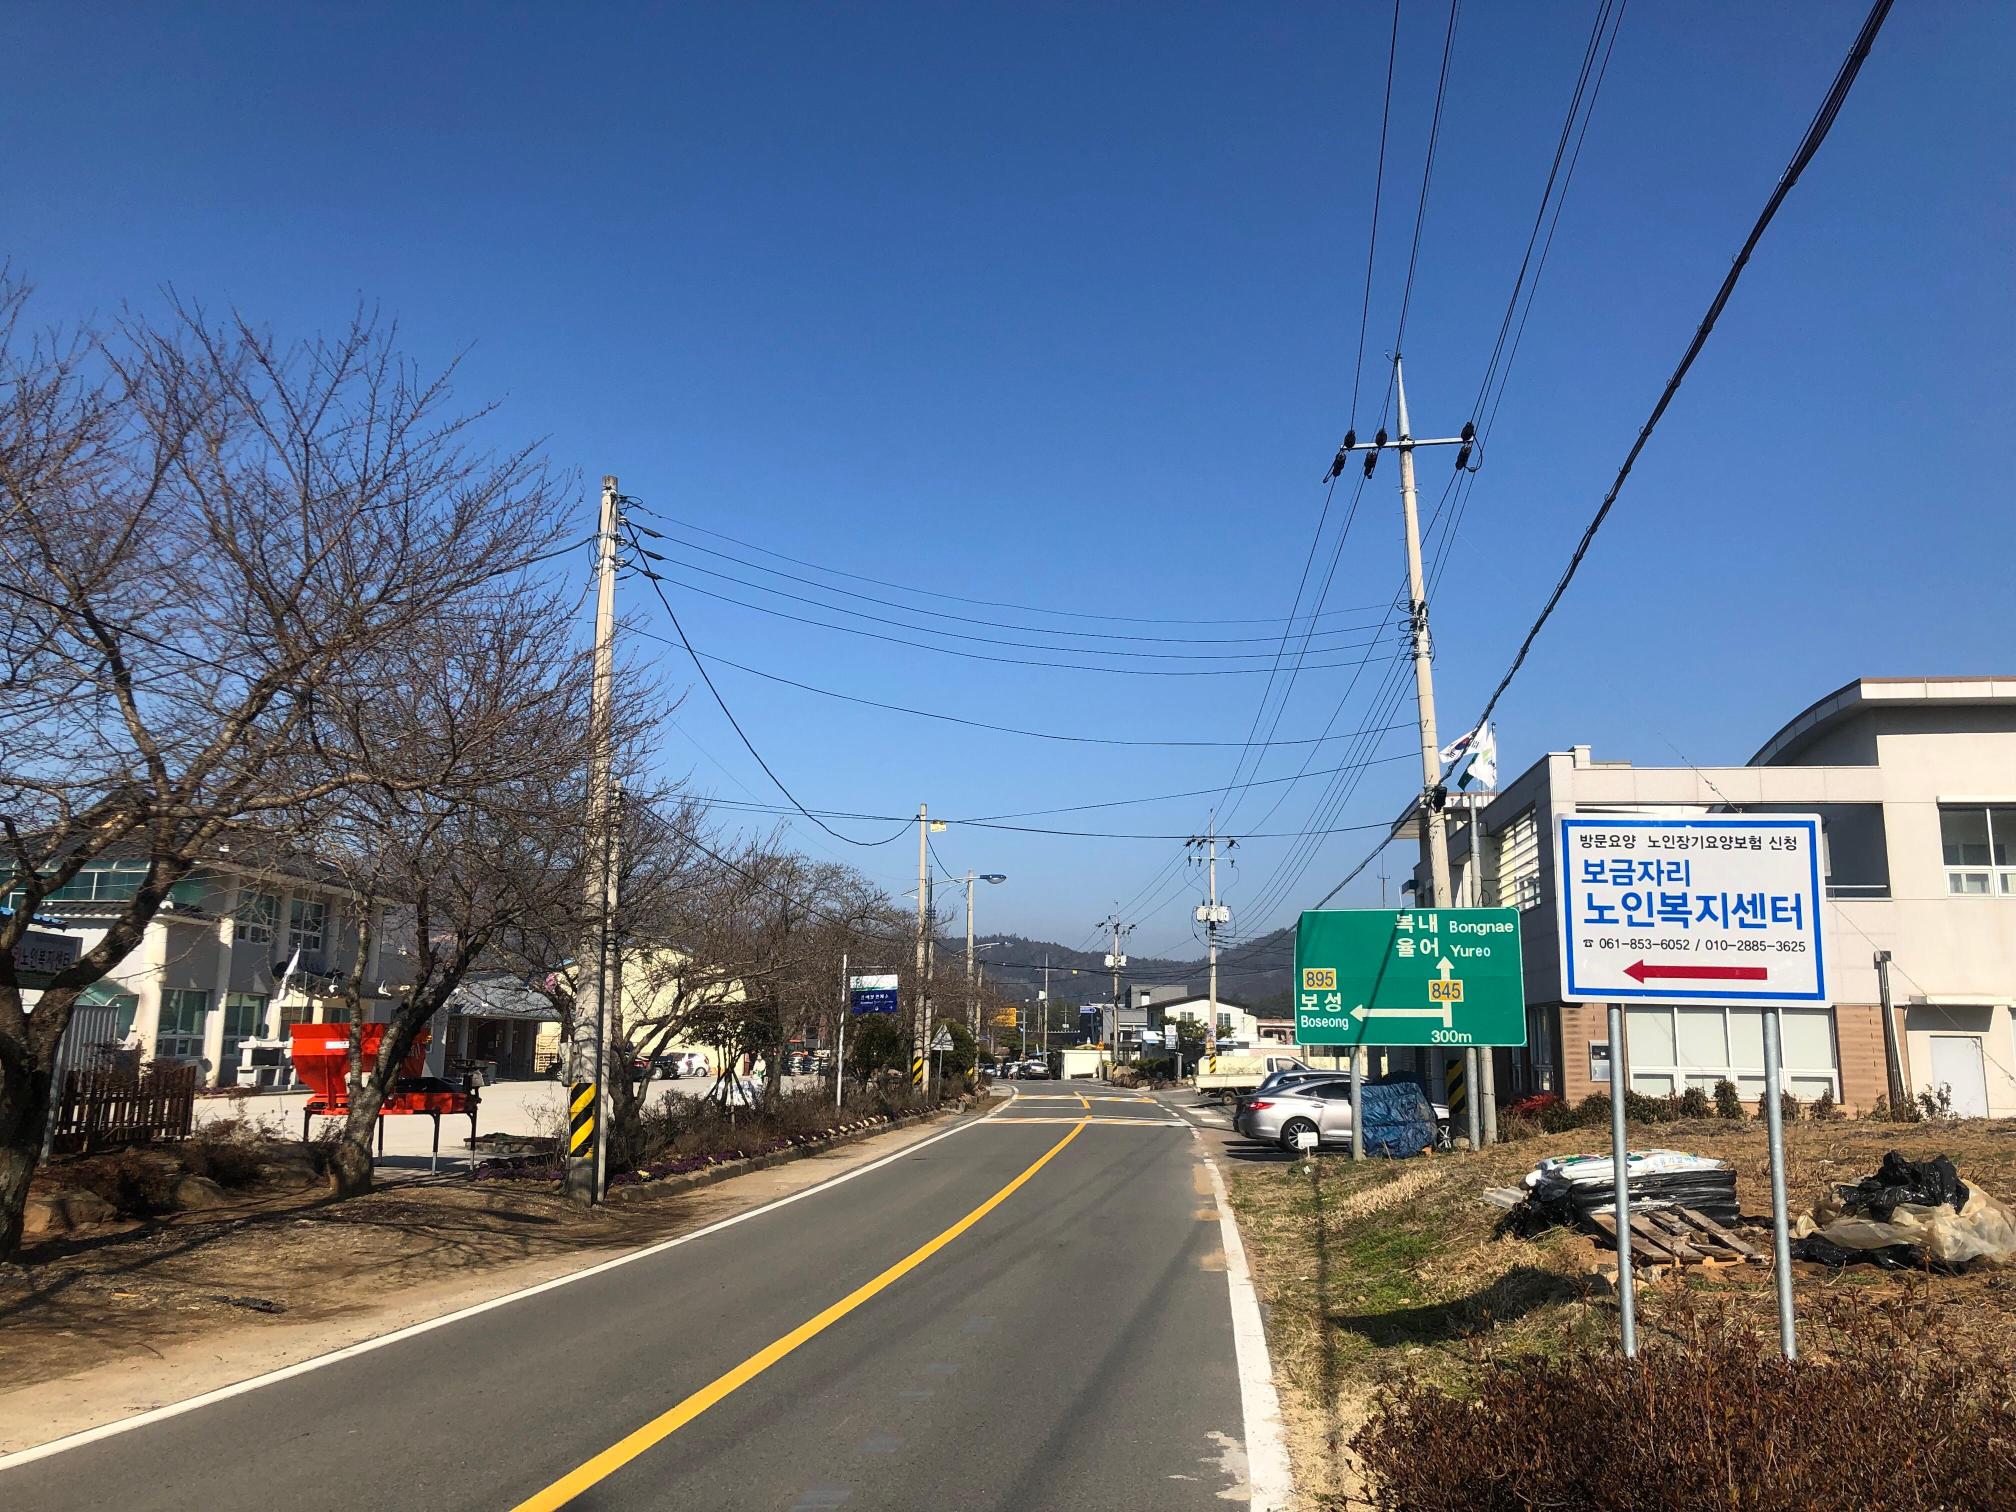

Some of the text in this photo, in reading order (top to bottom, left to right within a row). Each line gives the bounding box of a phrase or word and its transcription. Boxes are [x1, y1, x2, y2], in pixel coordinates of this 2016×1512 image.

[1579, 833, 1798, 851] 방문요양 노인장기요양보험 신청
[1581, 858, 1690, 887] 보금자리
[1583, 891, 1803, 930] 노인복지센터
[1394, 913, 1514, 935] 복내 Bongnae
[1395, 937, 1491, 957] 율어 Yureo
[1599, 938, 1690, 950] 061-853-6052
[1705, 939, 1806, 952] 010-2885-3625
[1306, 971, 1334, 987] 895
[1431, 982, 1461, 999] 845
[1300, 992, 1342, 1012] 보성
[1300, 1015, 1349, 1031] Boseong
[1431, 1030, 1472, 1043] 300m
